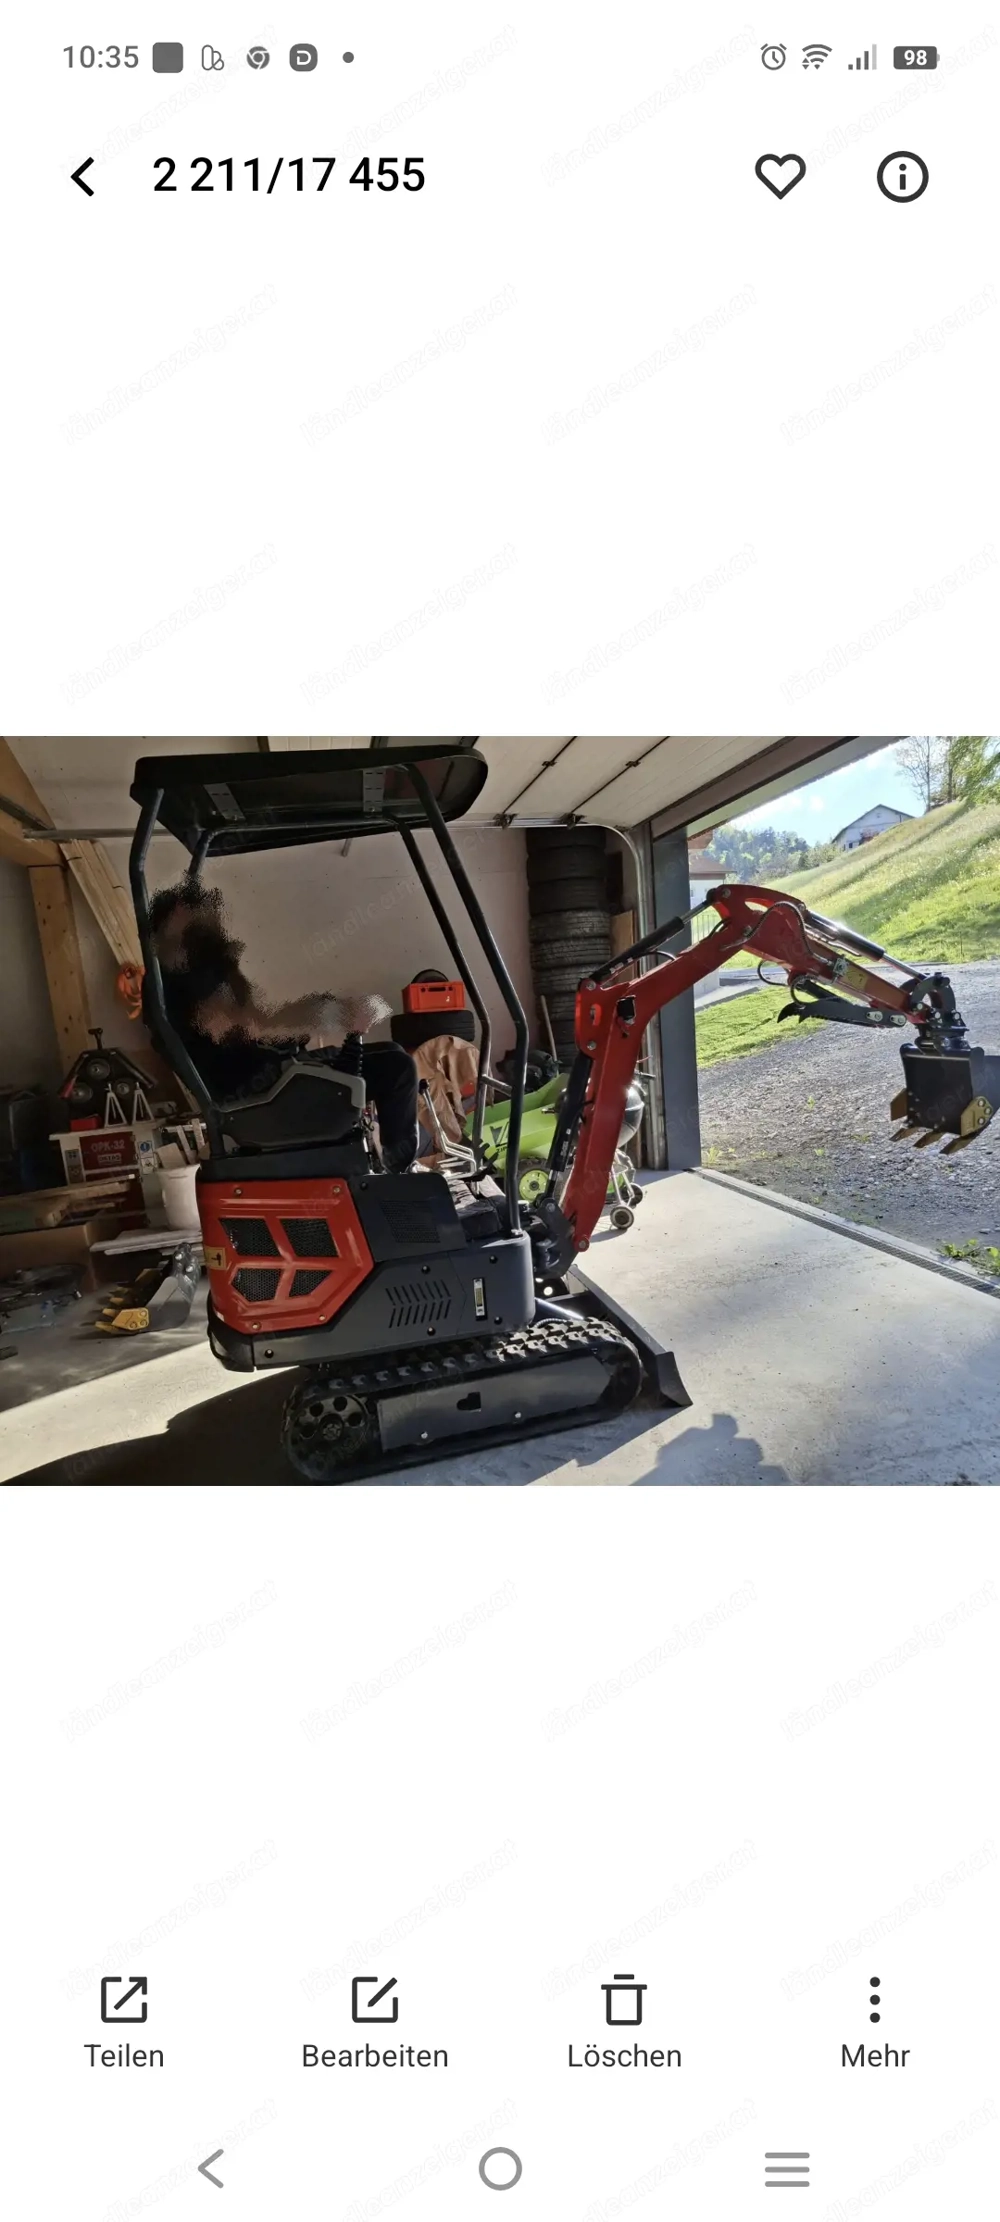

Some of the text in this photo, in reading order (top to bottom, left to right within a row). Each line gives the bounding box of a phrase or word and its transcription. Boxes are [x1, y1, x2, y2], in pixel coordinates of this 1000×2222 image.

[63, 45, 139, 69] 10:35
[904, 49, 927, 66] 98
[153, 156, 425, 195] 2 211/17 455
[83, 2042, 164, 2068] Teilen
[302, 2042, 448, 2068] Bearbeiten
[568, 2042, 682, 2068] Löschen
[841, 2042, 911, 2068] Mehr
